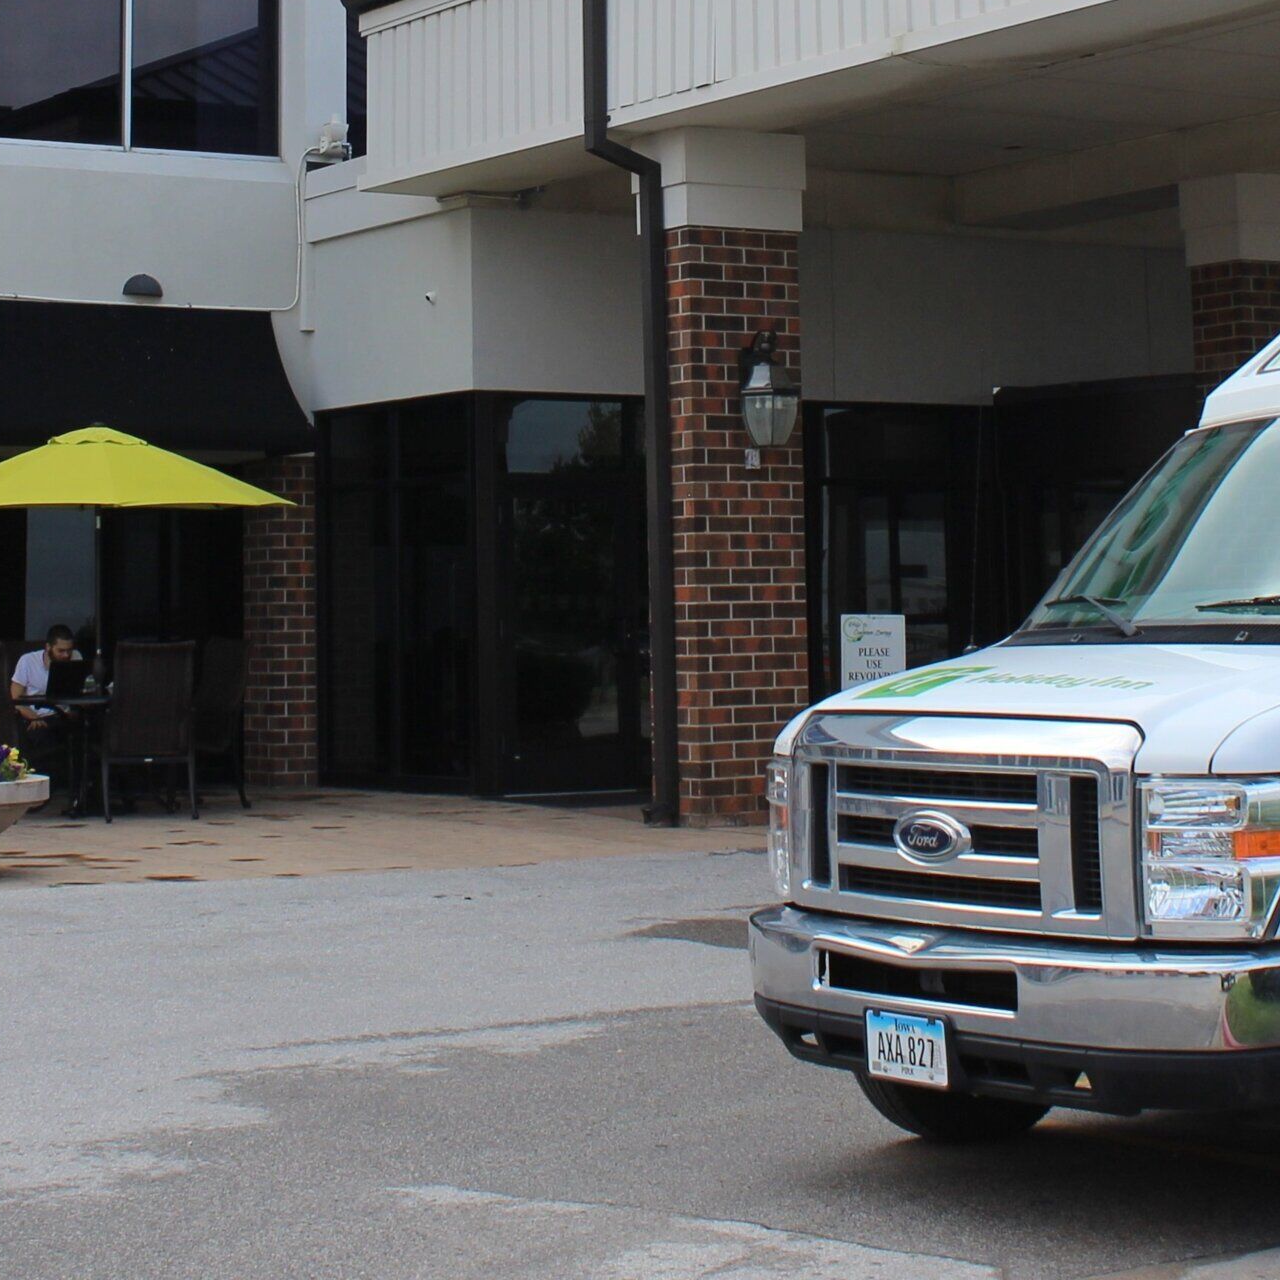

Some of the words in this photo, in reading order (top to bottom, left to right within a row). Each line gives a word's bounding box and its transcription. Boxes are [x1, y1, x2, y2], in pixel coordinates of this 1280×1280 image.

[858, 647, 891, 657] PLEASE
[866, 659, 883, 669] USE
[848, 671, 898, 681] REVOLVI
[964, 672, 1095, 689] Holiday
[1089, 675, 1156, 691] Inn
[908, 824, 939, 847] Ford
[878, 1032, 904, 1064] AXA
[908, 1036, 935, 1069] 827
